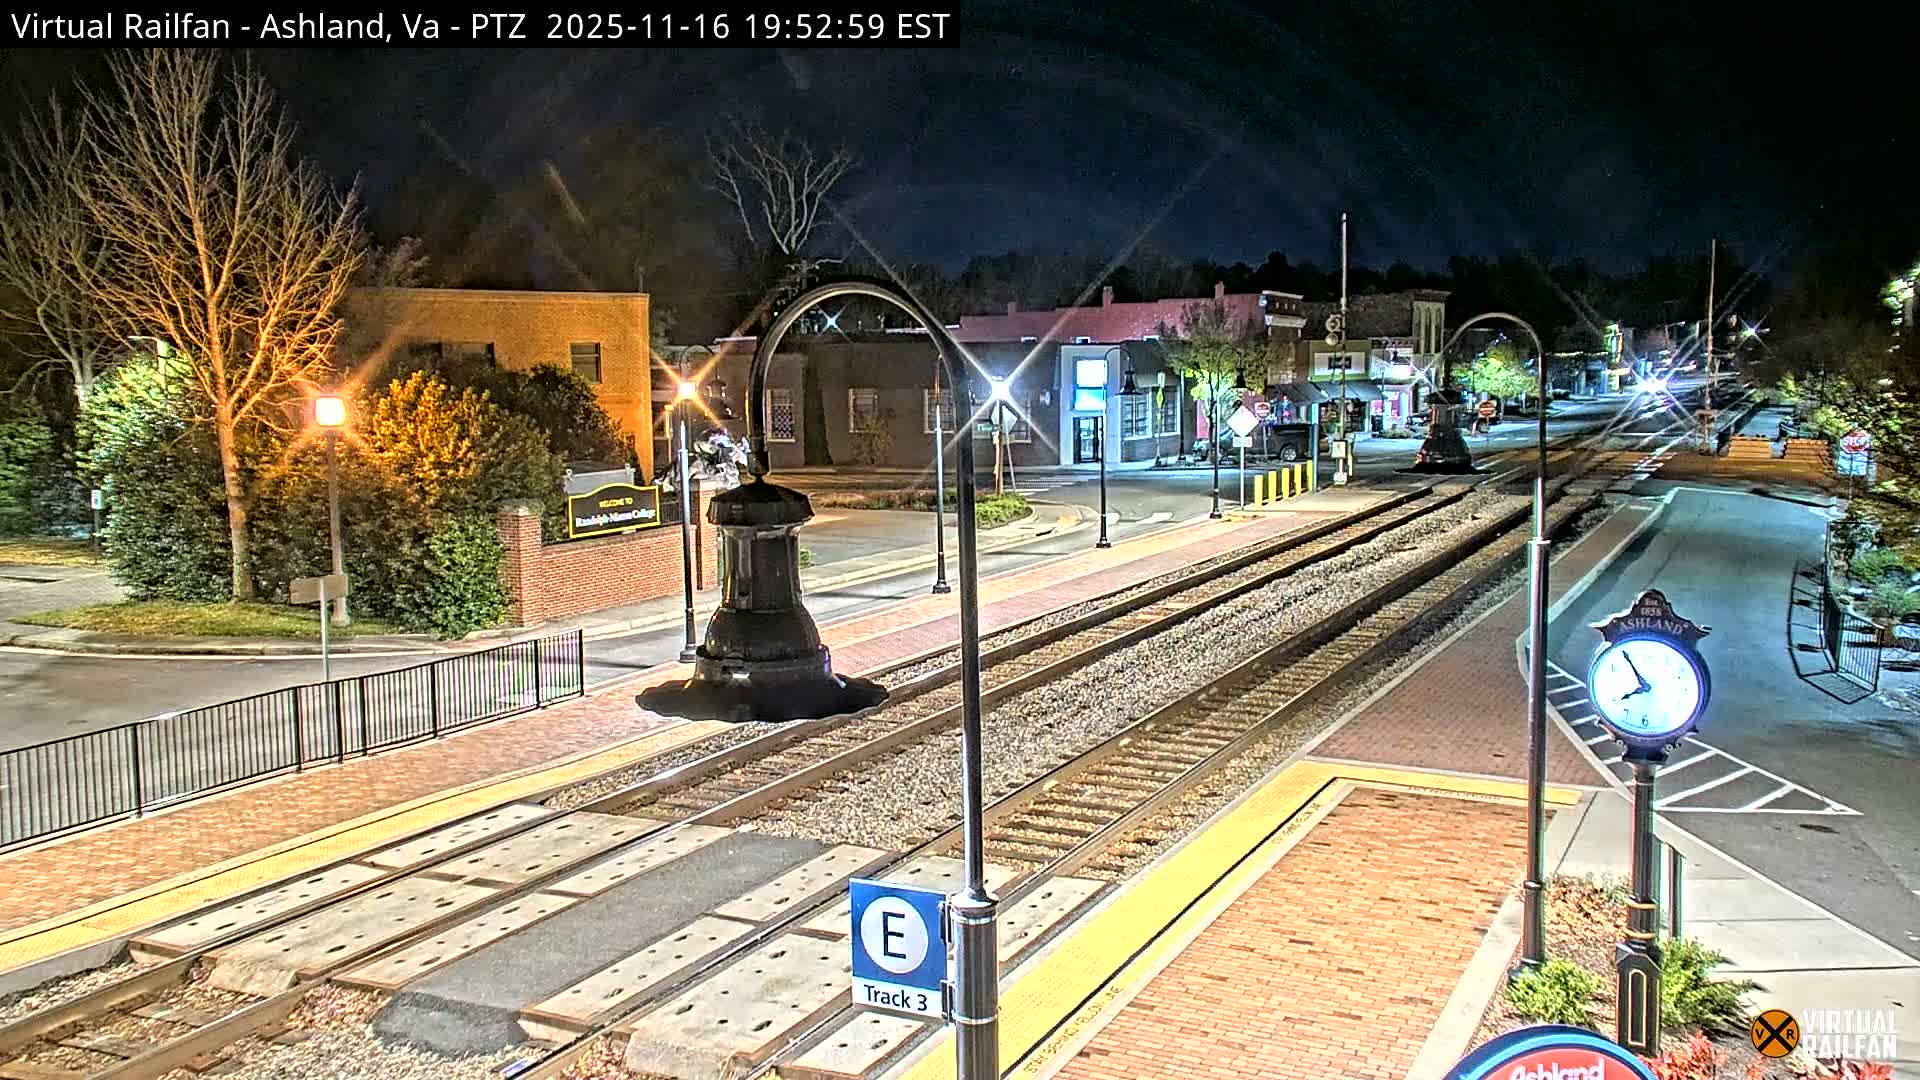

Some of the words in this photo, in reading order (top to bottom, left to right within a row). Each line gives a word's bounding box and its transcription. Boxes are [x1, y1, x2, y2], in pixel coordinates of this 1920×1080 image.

[1621, 617, 1684, 635] ASHLAND
[882, 911, 907, 960] E
[863, 984, 911, 1009] Track
[917, 994, 928, 1012] 3
[1510, 1056, 1605, 1080] Ashland
